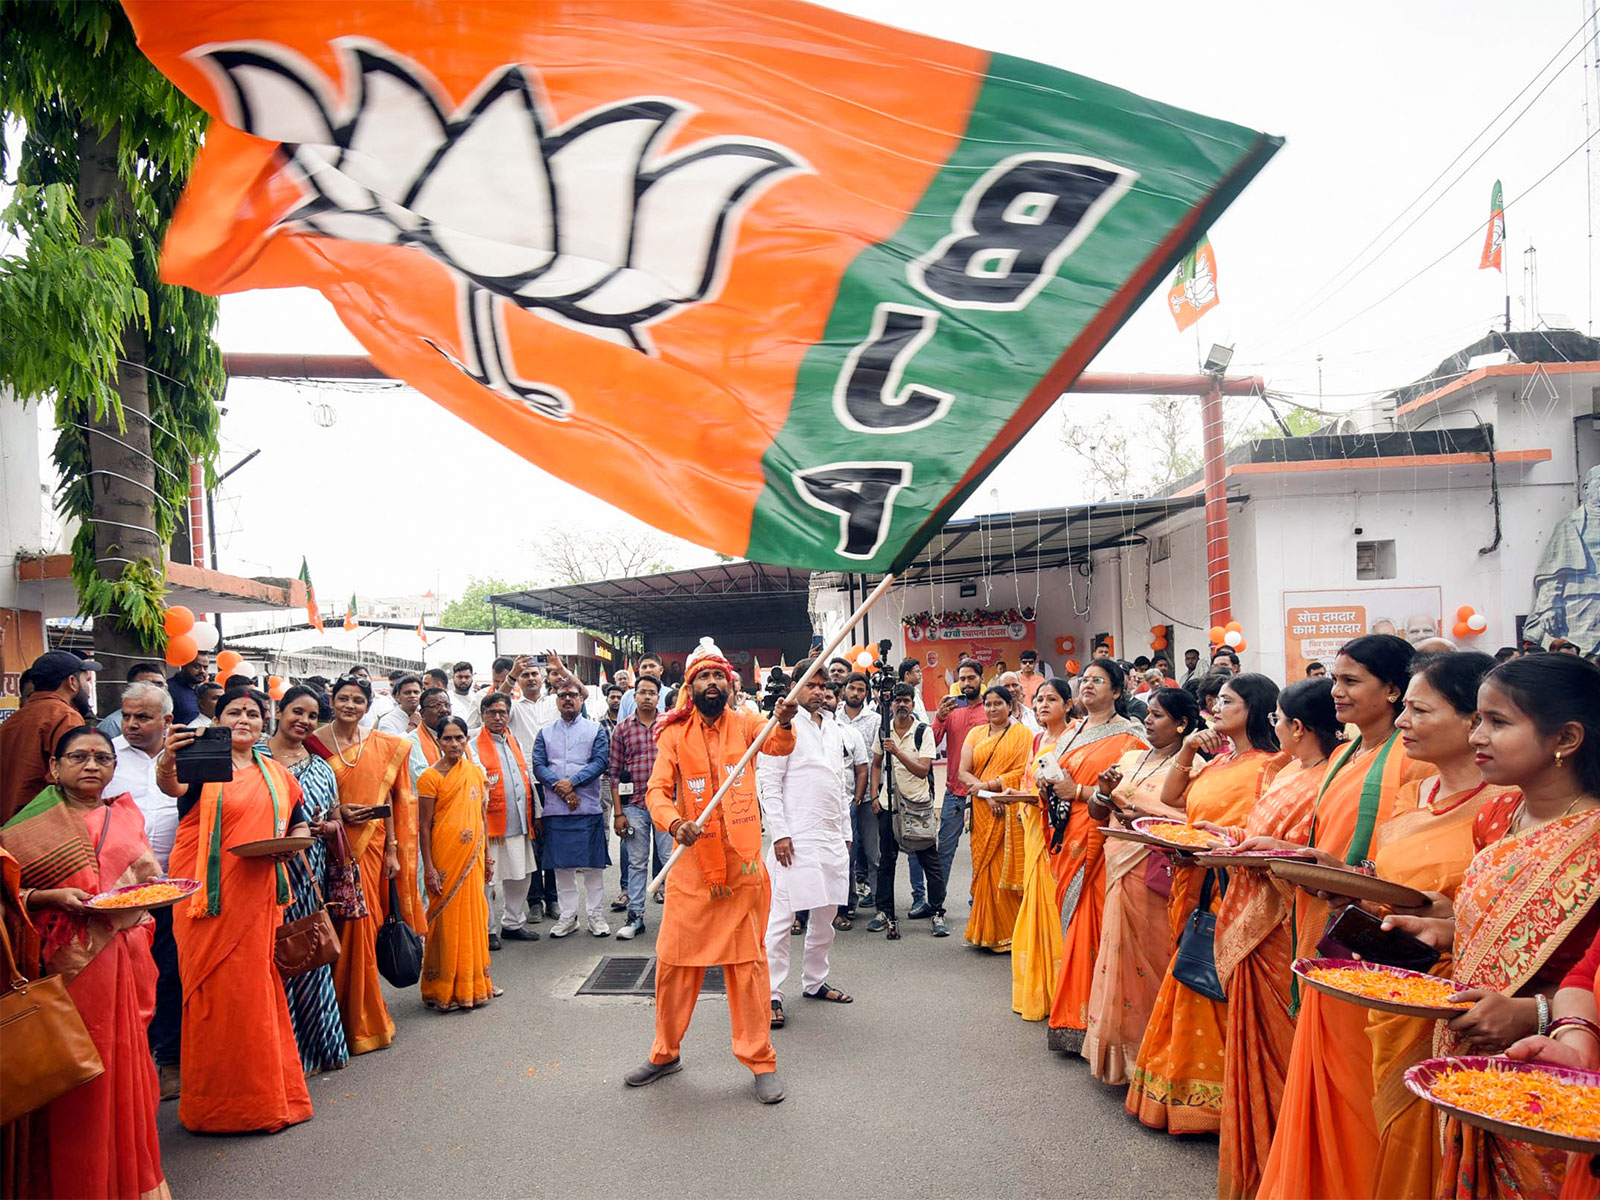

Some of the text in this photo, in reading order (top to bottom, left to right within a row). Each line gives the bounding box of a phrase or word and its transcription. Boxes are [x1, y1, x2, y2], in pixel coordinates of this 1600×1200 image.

[1297, 610, 1356, 623] सोच दमदार
[961, 630, 986, 638] स्थापना
[987, 627, 1006, 637] दिवस
[1292, 623, 1361, 635] काम असरदार
[732, 815, 756, 825] भाजपा
